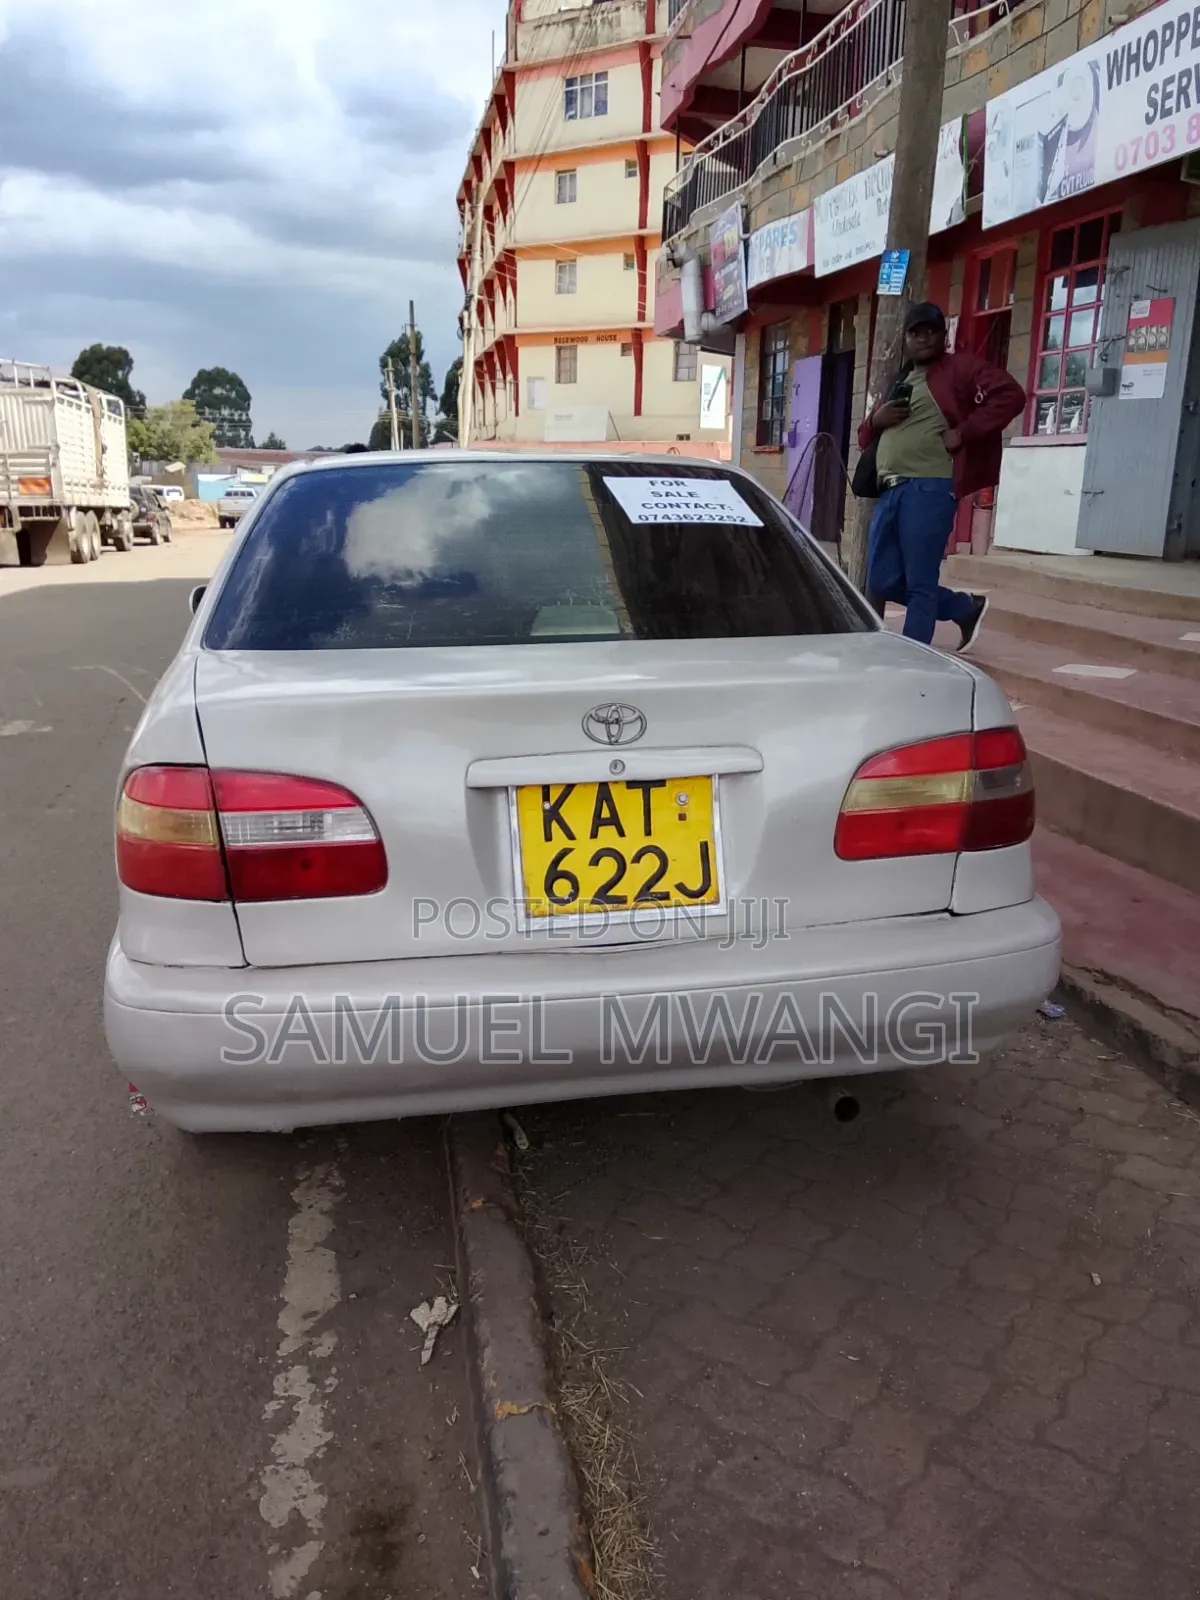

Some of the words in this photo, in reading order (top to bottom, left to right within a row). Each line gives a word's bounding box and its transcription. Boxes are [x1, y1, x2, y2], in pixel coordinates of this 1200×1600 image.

[1114, 123, 1176, 171] 0703
[553, 335, 589, 345] ROSEWOOD
[596, 333, 618, 343] HOUSE
[638, 513, 749, 523] 0743623252
[641, 502, 734, 511] CONTACT:
[541, 780, 667, 842] KAT
[544, 840, 711, 905] 622J
